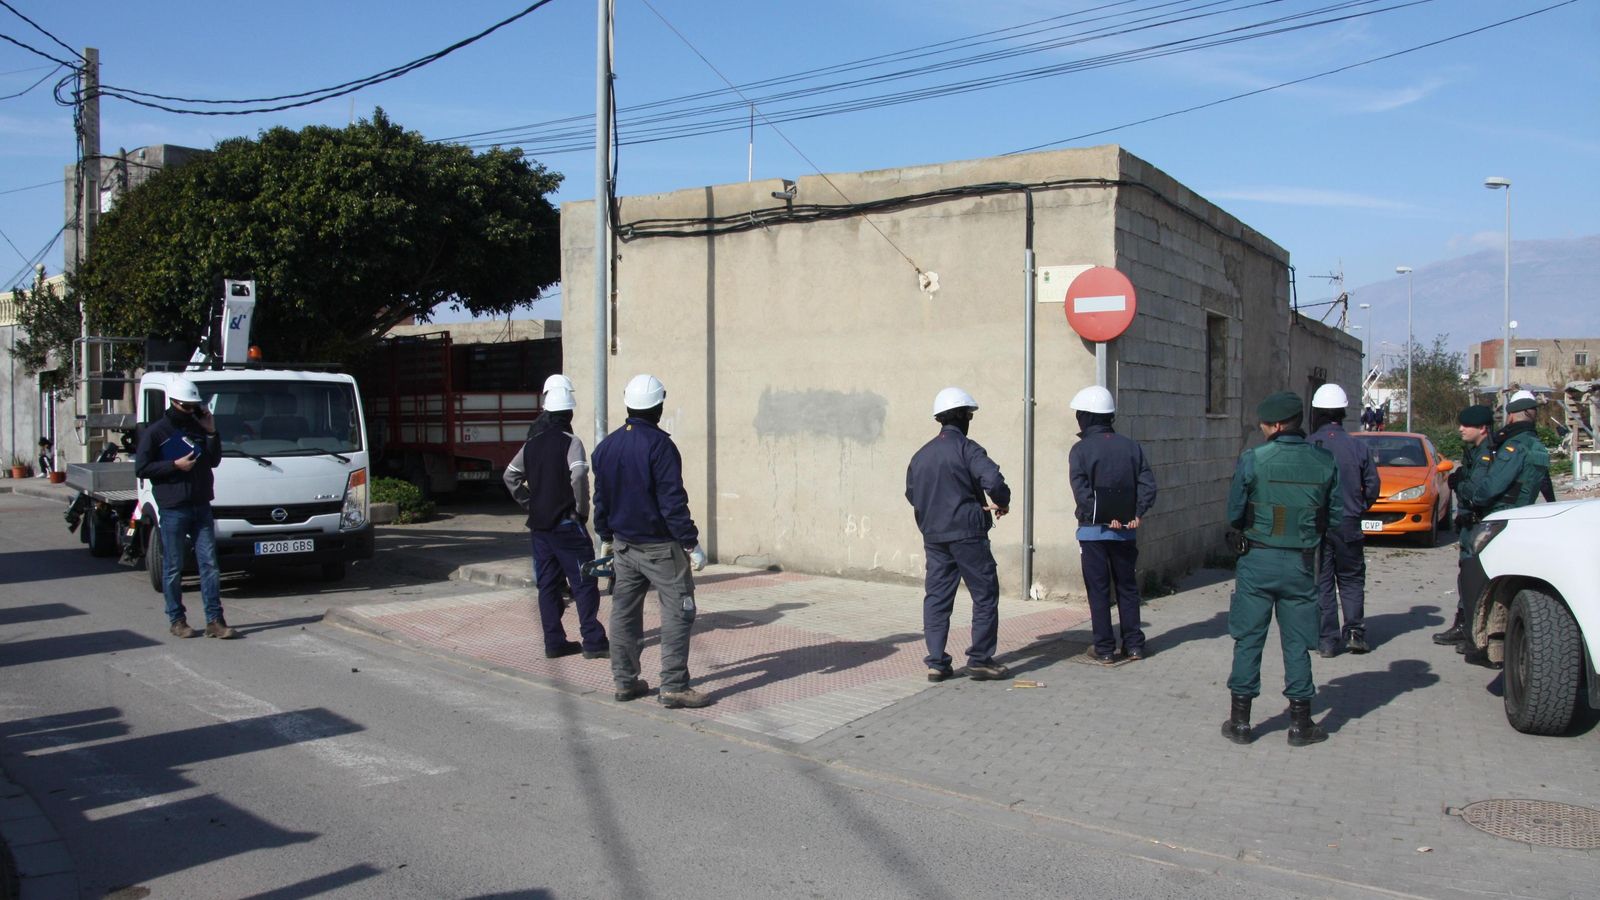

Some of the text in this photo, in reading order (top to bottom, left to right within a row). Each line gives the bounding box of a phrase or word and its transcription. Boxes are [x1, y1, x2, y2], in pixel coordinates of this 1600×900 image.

[1364, 521, 1380, 530] CVP
[262, 540, 313, 553] 8208 GBS
